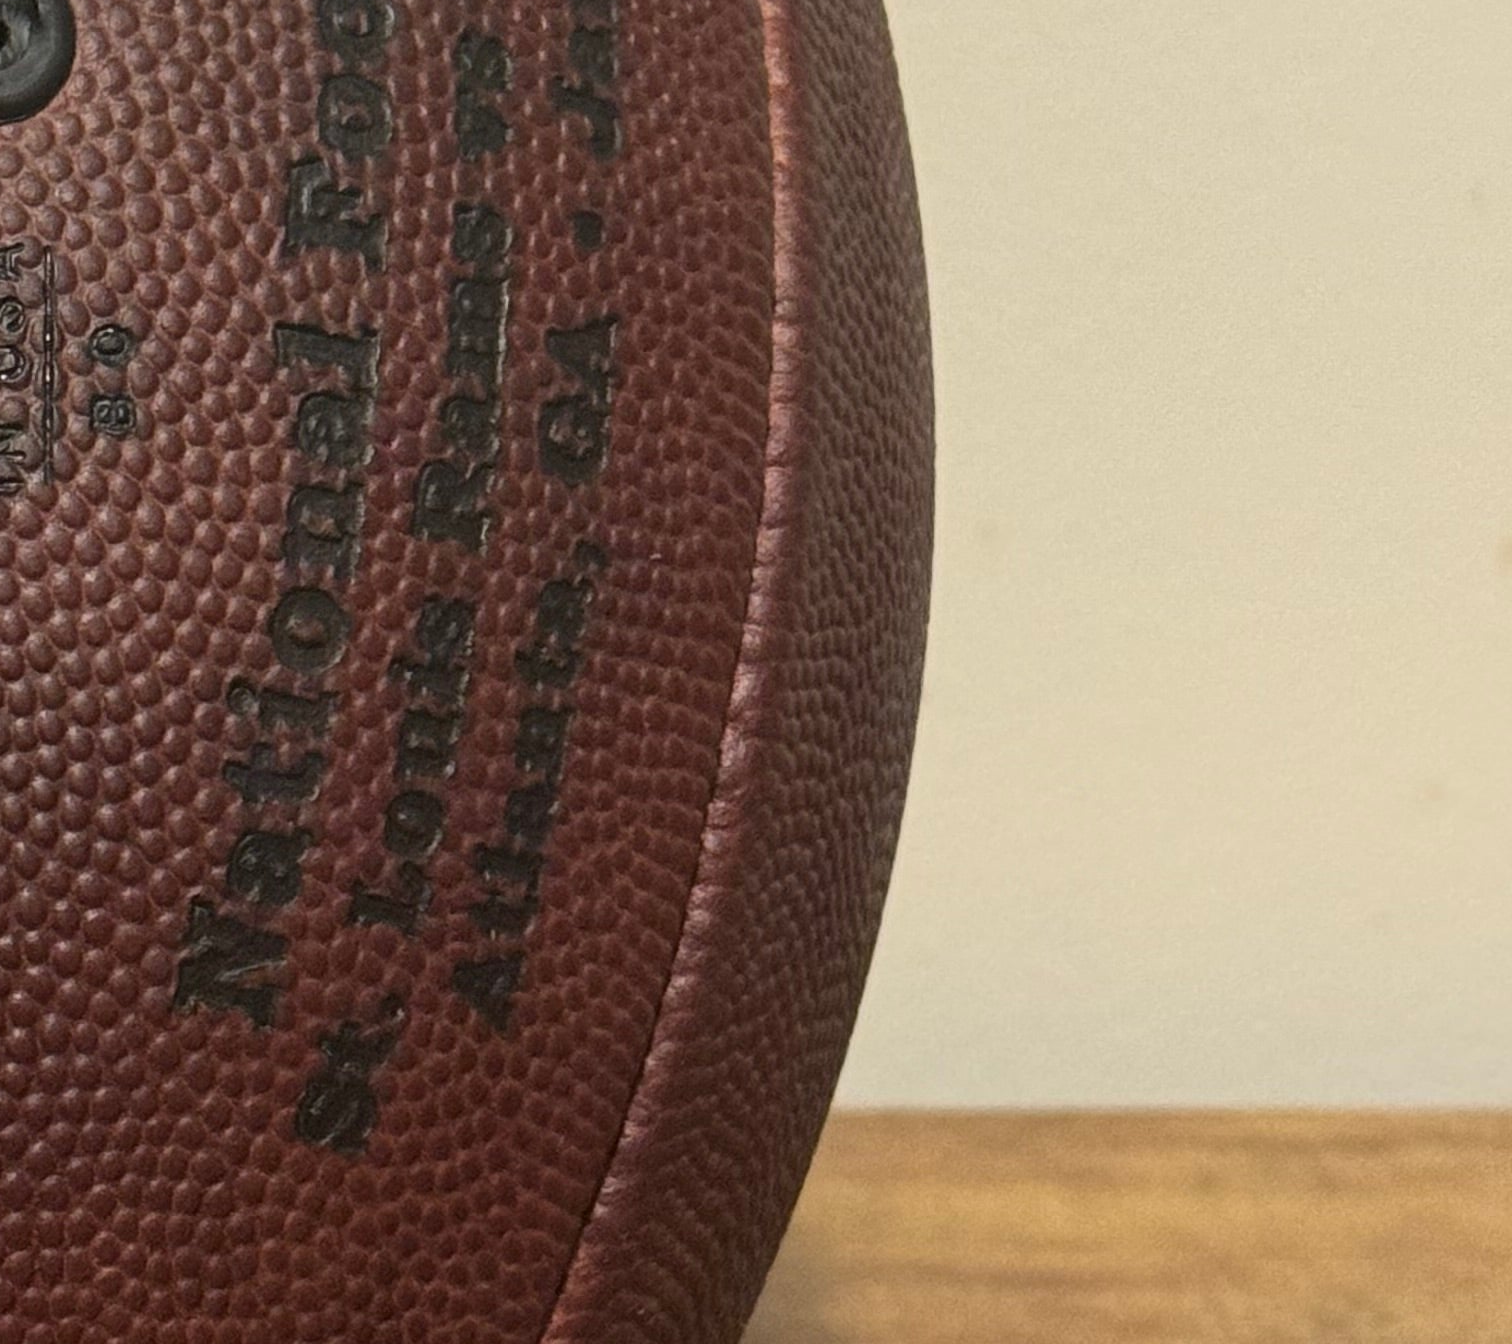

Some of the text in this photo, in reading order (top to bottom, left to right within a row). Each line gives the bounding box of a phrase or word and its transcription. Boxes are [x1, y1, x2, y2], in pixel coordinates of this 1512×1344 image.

[171, 322, 378, 1030] National
[348, 596, 475, 939] Louis
[413, 202, 512, 554] Rams
[538, 313, 620, 486] GA
